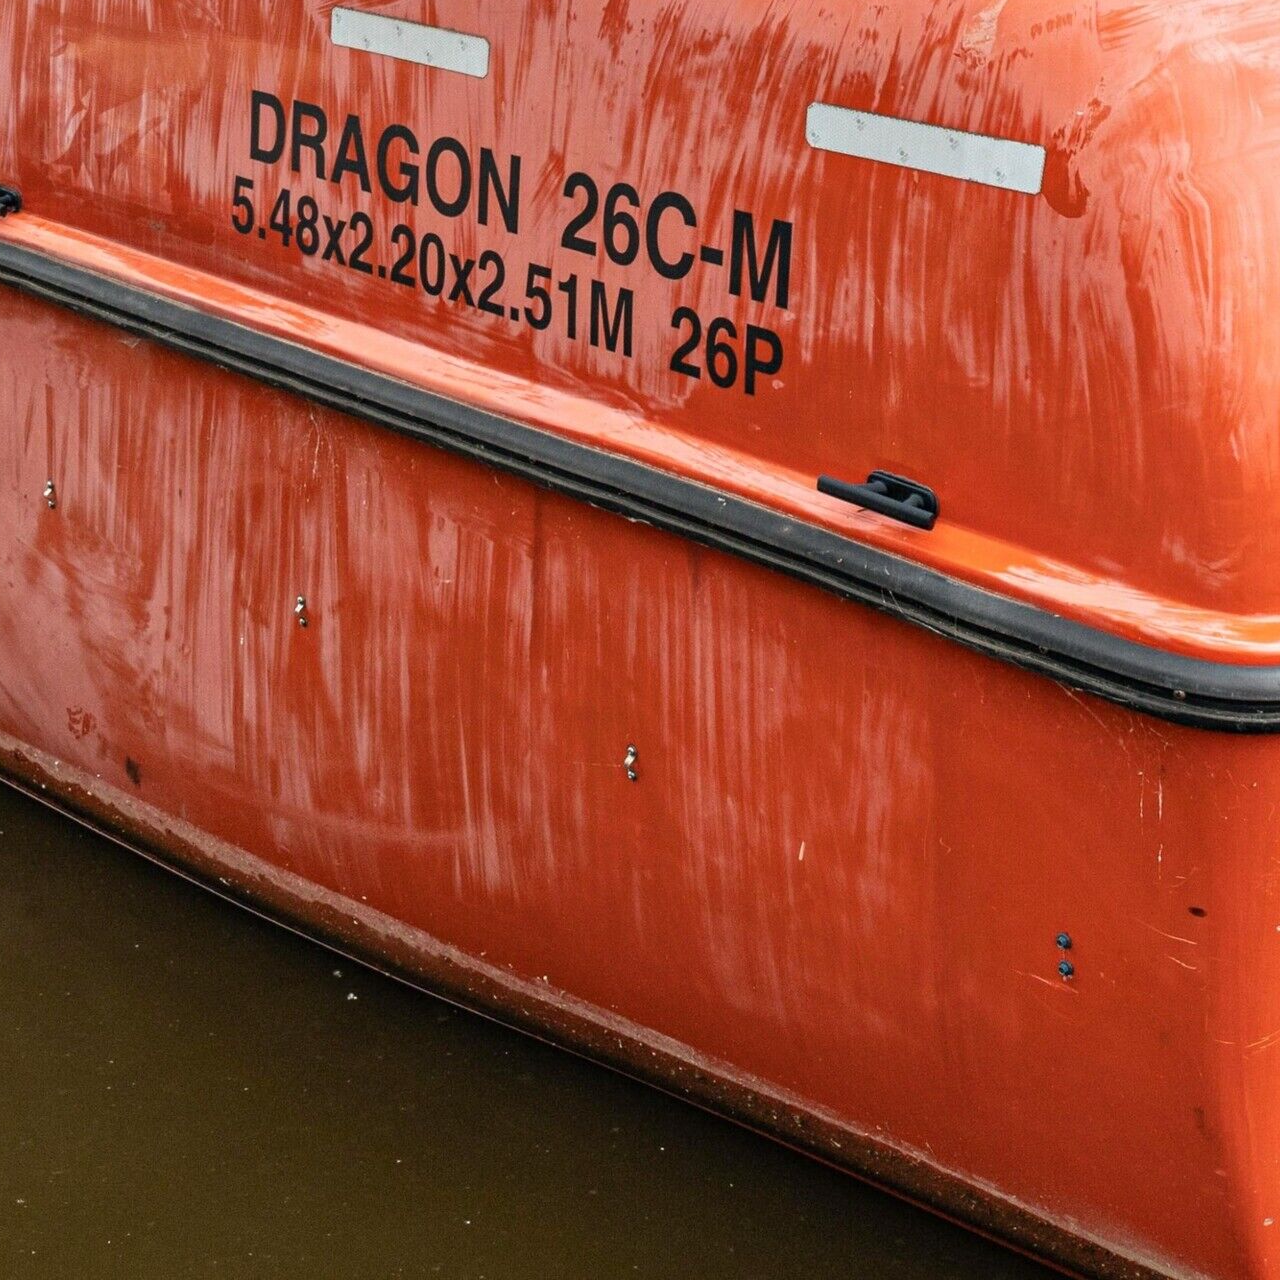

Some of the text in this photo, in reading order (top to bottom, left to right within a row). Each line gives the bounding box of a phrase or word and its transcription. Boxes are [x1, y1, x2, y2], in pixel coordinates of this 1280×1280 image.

[231, 176, 784, 396] 5.48x2.20x2.51M 26P
[249, 90, 794, 309] DRAGON 26C-M
